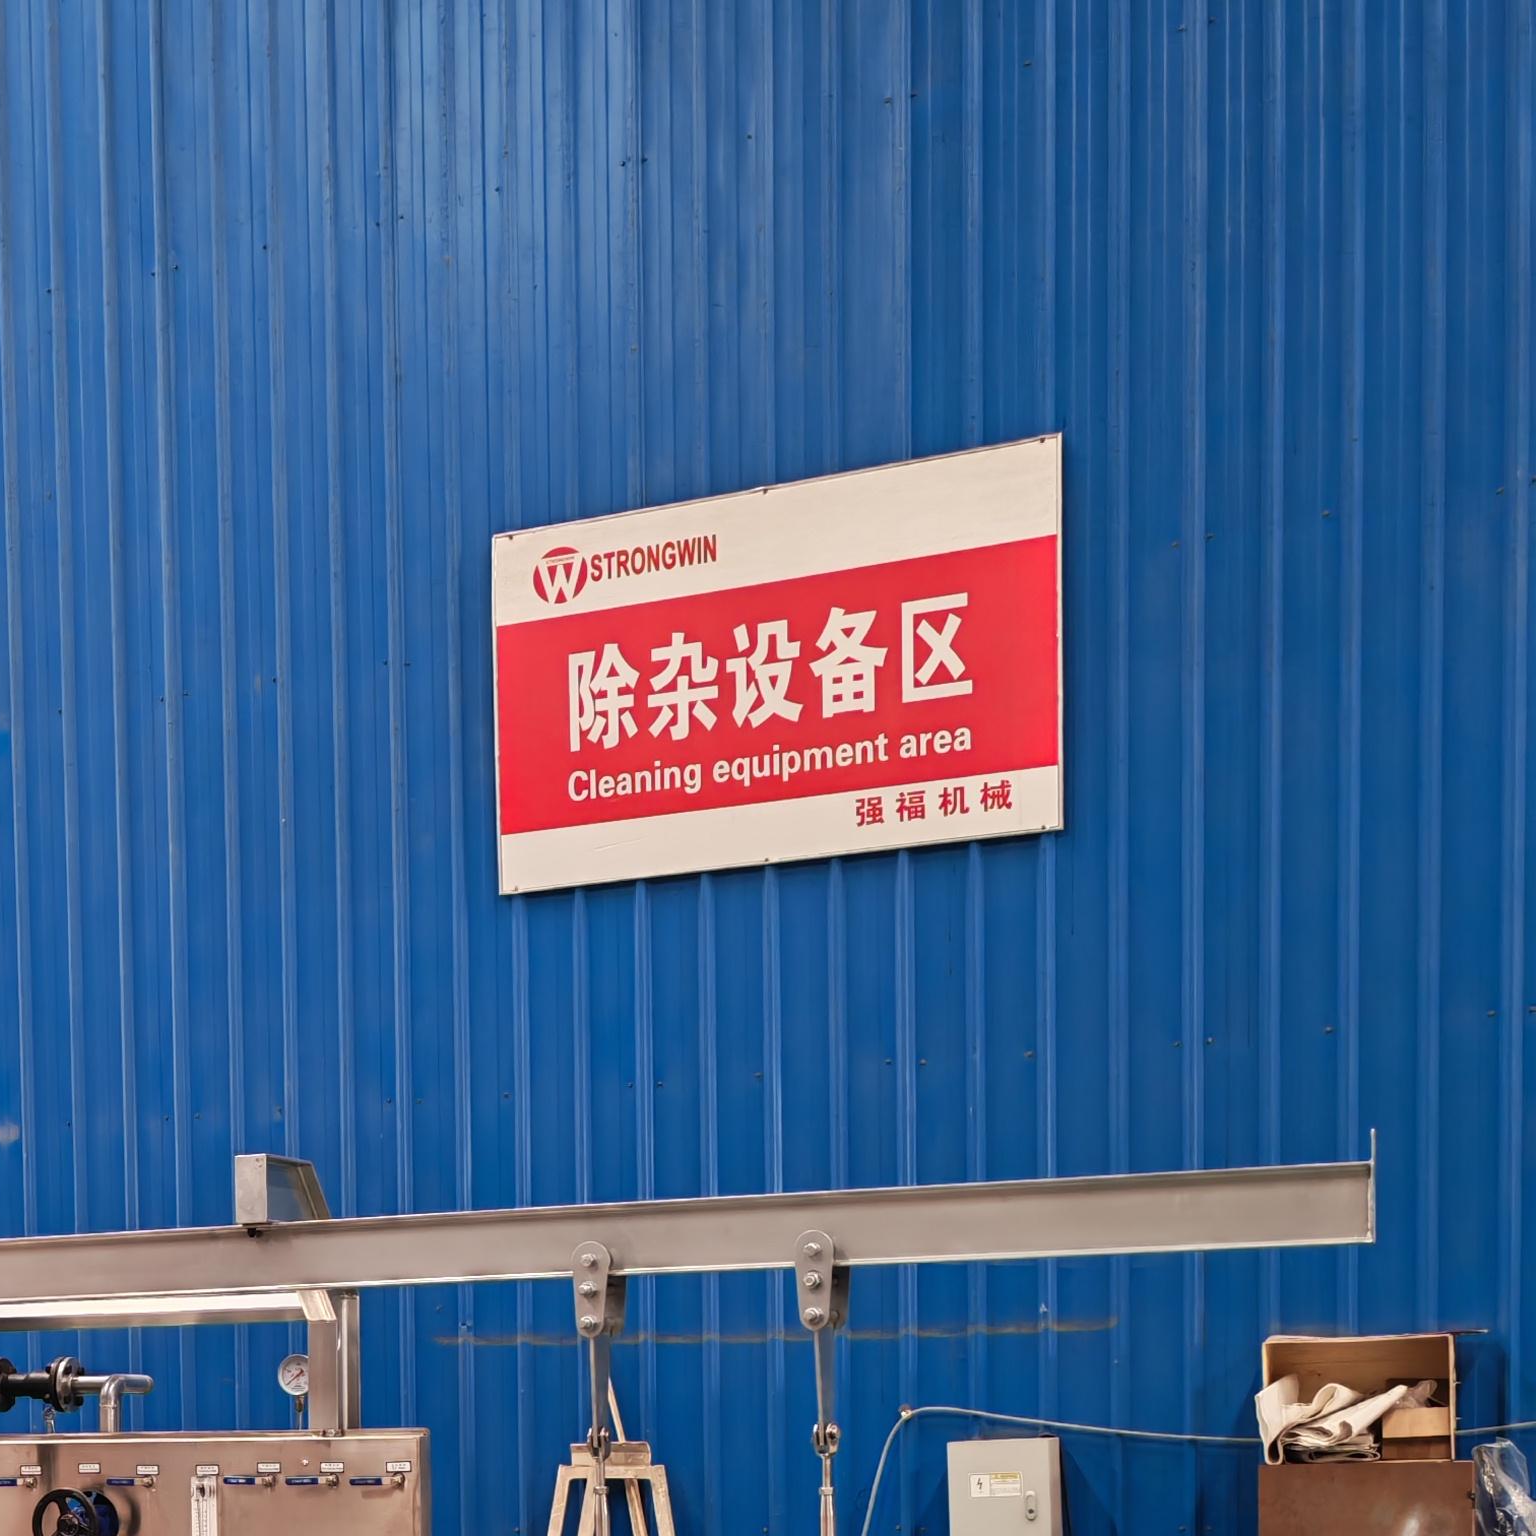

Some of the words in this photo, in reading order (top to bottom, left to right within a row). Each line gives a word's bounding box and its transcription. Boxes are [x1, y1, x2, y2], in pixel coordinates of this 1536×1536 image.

[590, 534, 718, 582] STRONGWIN
[568, 592, 974, 753] 除杂设备区
[567, 760, 702, 802] Cleaning
[713, 732, 889, 787] equipment
[899, 726, 972, 759] area
[855, 779, 1013, 827] 强福机械
